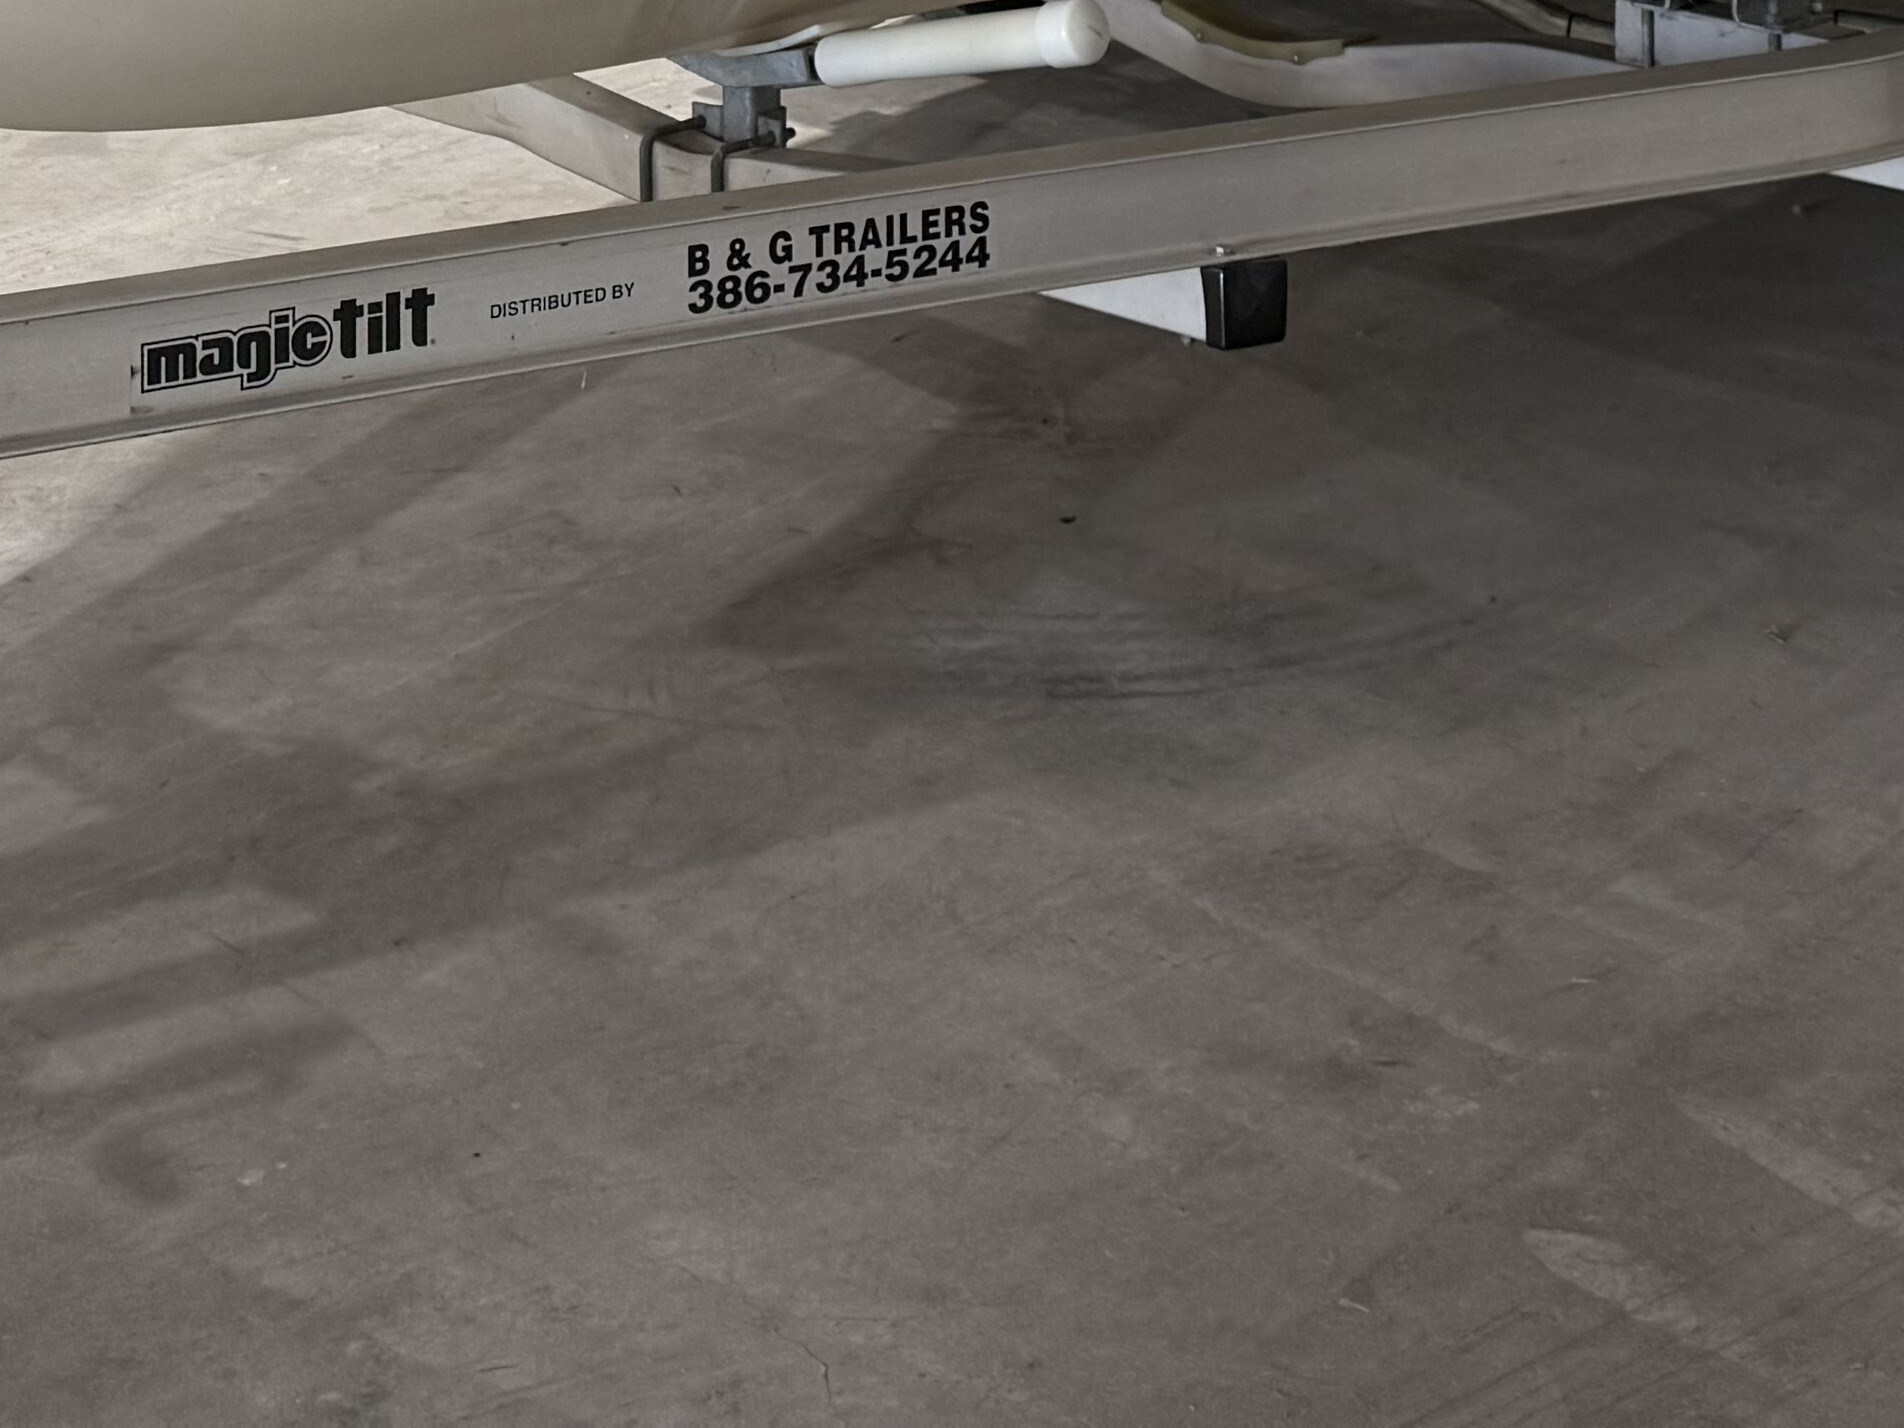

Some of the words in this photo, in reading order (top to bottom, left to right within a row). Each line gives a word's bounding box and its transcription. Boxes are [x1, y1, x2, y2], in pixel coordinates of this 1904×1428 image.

[687, 243, 711, 278] B
[726, 237, 752, 272] &
[768, 230, 794, 265] G
[808, 200, 990, 258] TRAILERS
[687, 235, 992, 314] 386-734-5244
[490, 286, 607, 319] DISTRIBUTED
[611, 281, 635, 300] BY
